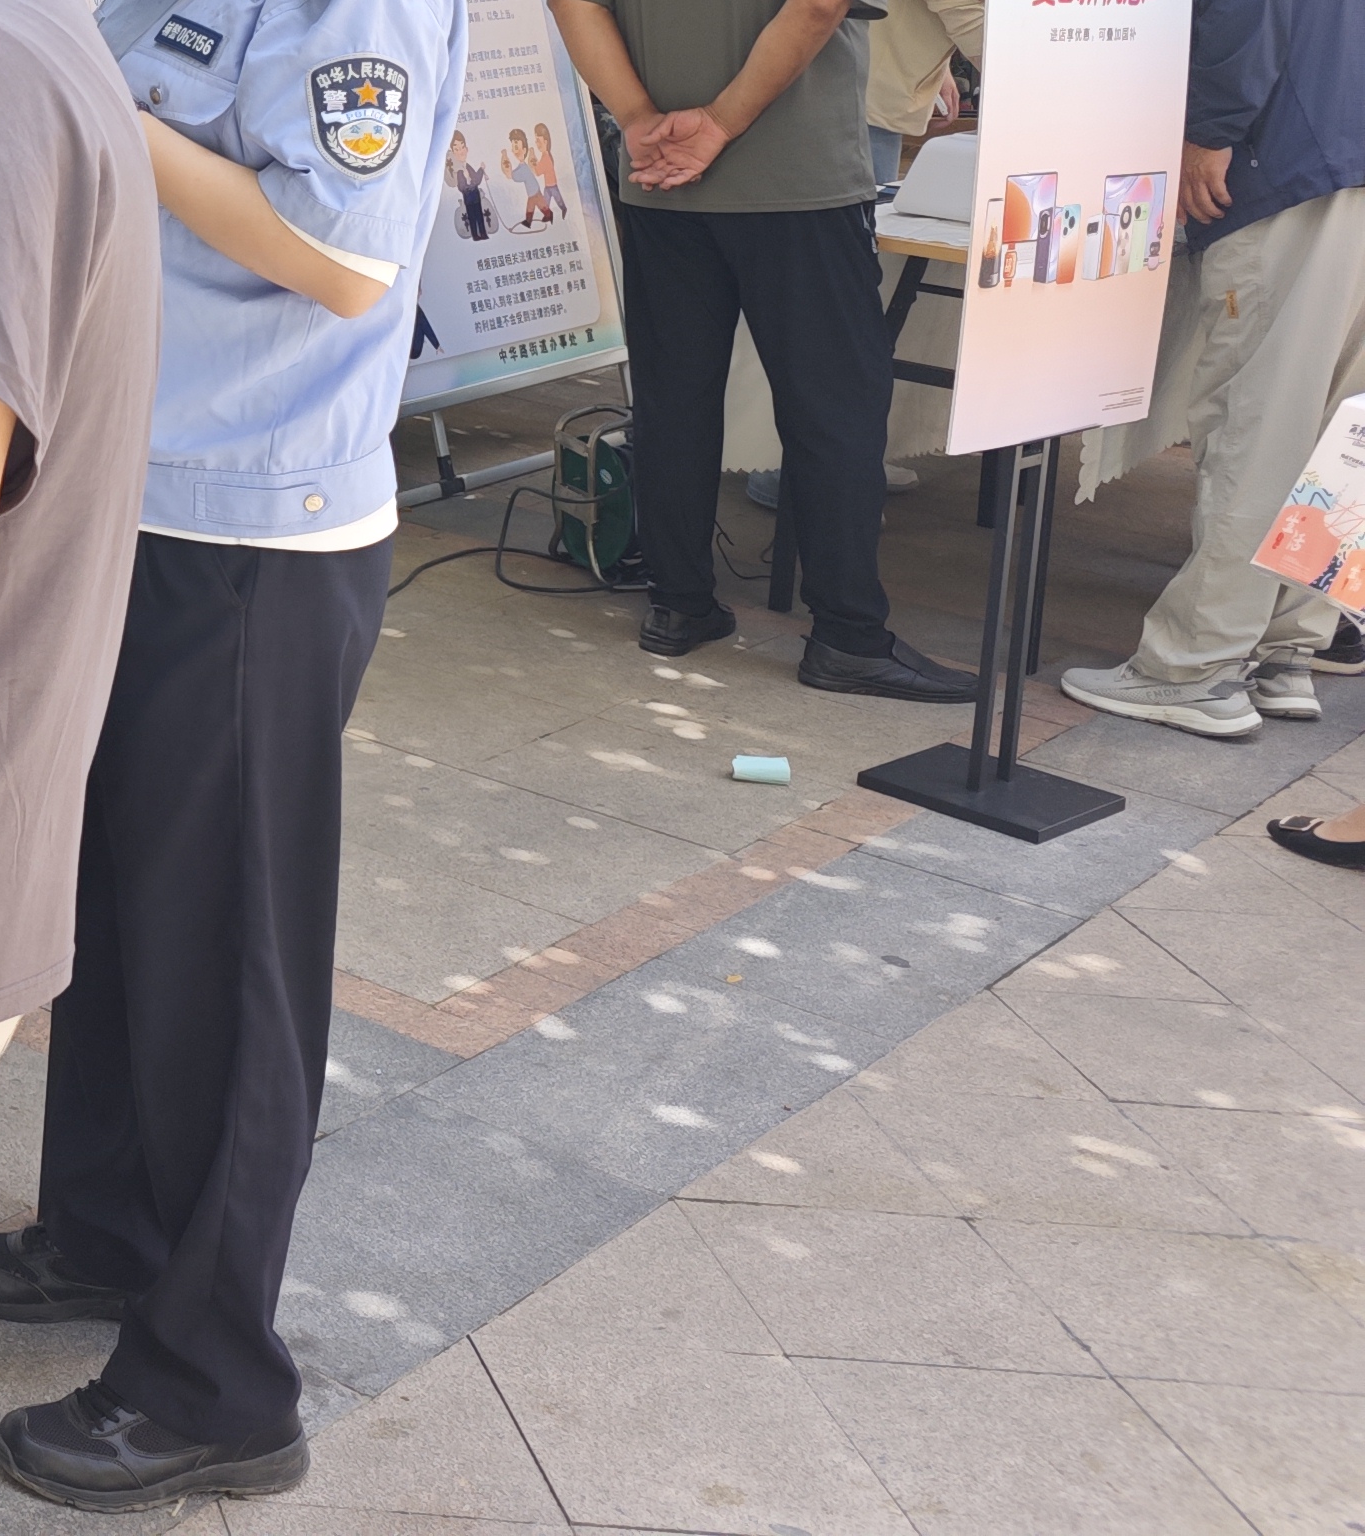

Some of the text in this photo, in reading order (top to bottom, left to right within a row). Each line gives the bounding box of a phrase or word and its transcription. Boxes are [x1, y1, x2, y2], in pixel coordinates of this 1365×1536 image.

[316, 61, 406, 92] 中华人民共和国
[323, 90, 402, 111] 警 察
